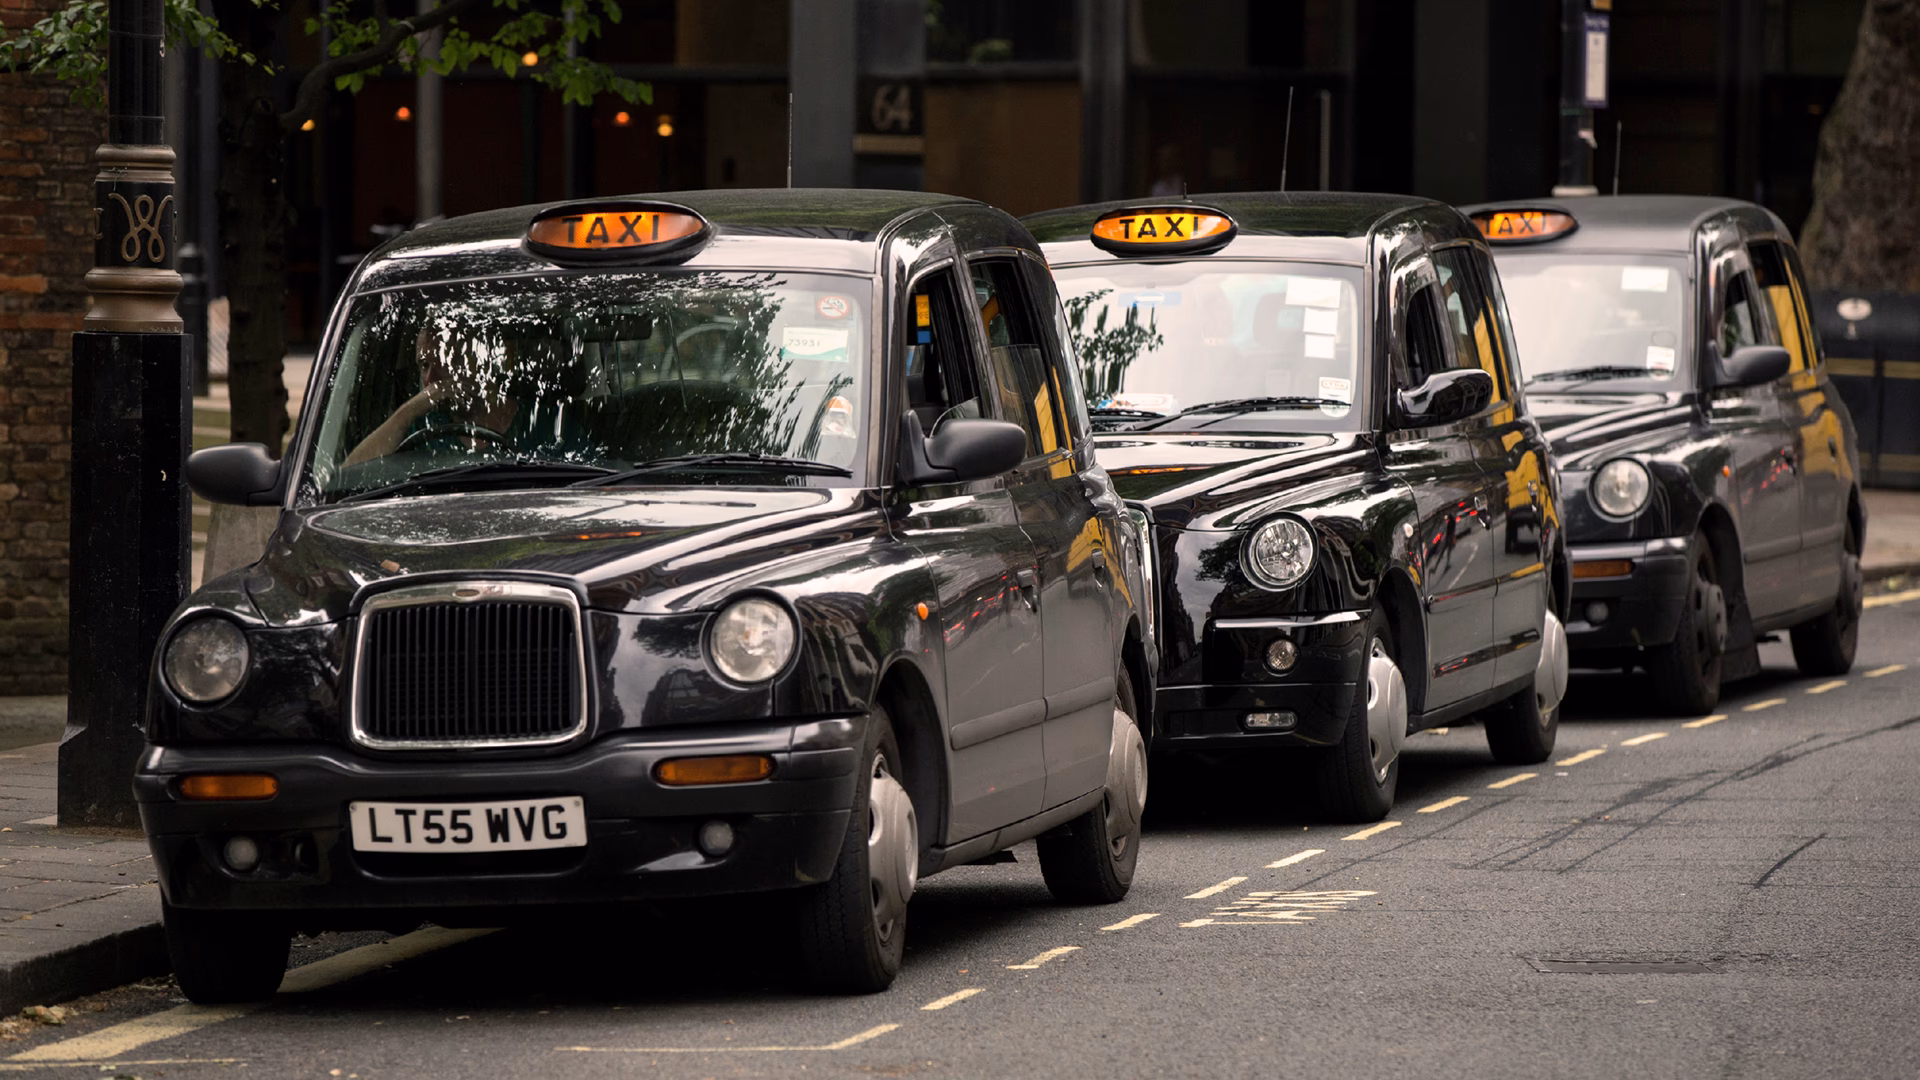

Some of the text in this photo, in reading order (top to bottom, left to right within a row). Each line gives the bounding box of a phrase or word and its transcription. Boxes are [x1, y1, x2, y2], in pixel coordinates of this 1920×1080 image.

[872, 85, 912, 131] 64
[562, 214, 660, 244] TAXI
[1119, 216, 1199, 239] TAXI
[1481, 211, 1547, 234] TAXI
[787, 338, 820, 347] 73931
[368, 804, 568, 844] LT55 WVG
